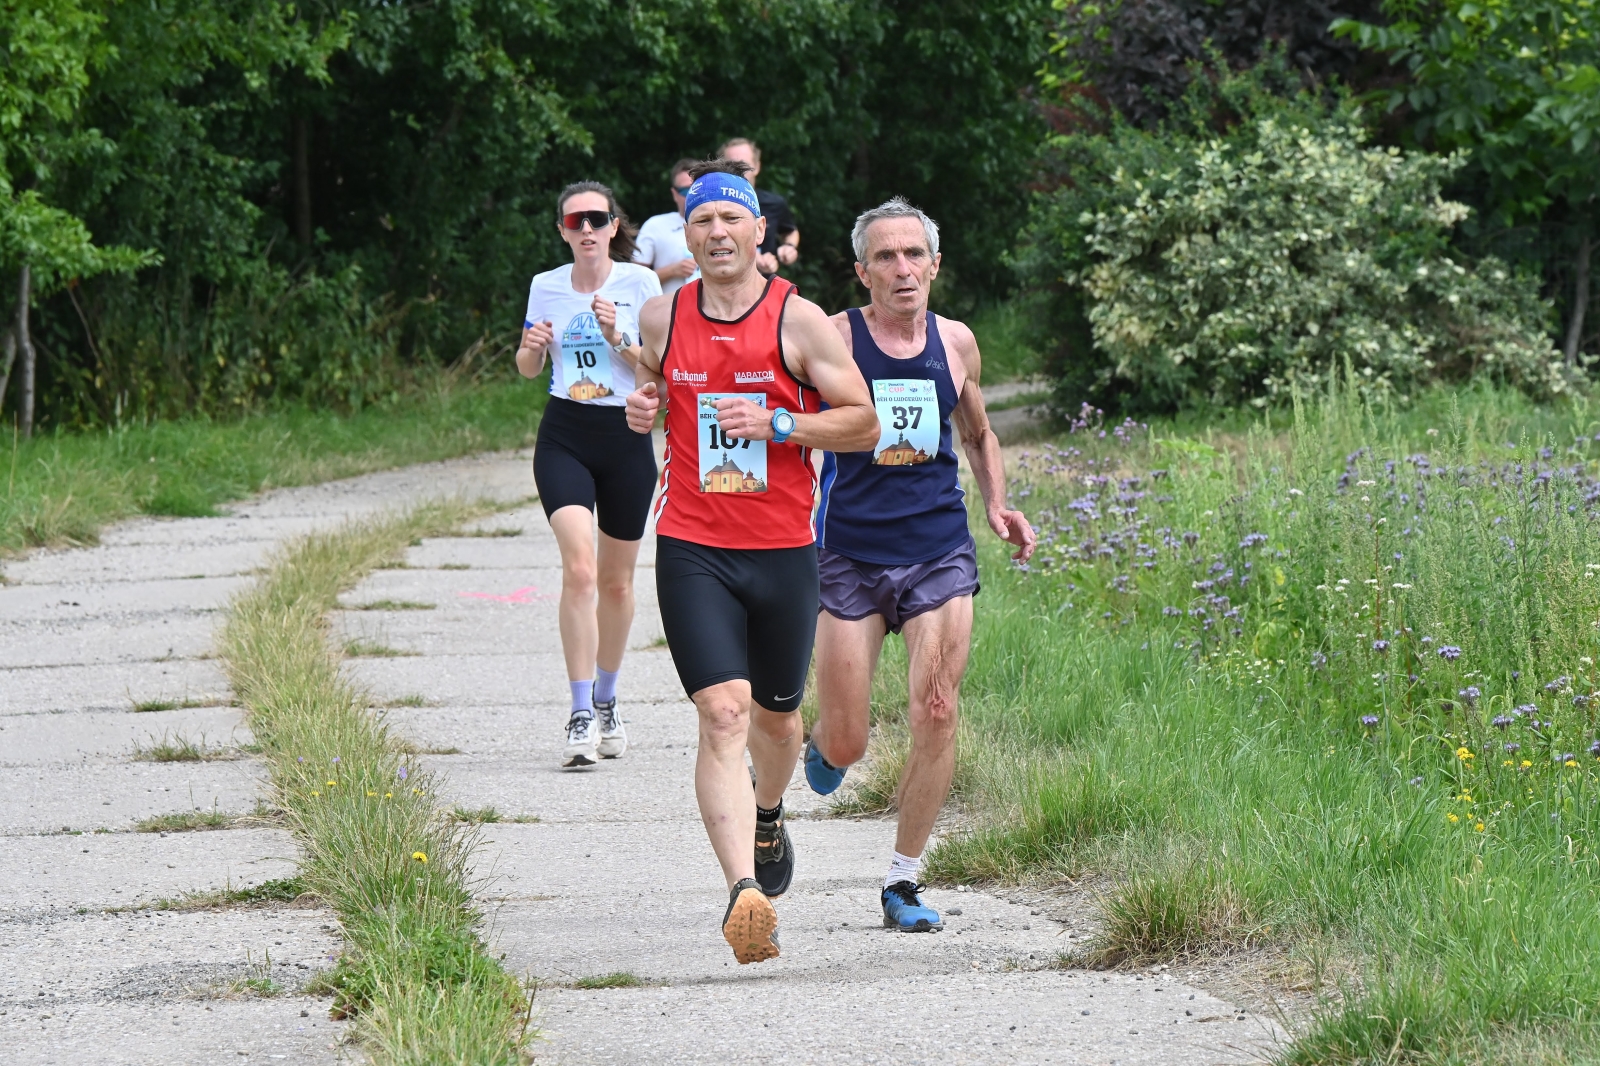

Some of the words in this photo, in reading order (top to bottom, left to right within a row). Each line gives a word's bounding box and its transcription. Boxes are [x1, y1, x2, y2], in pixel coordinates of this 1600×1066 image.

[575, 350, 597, 369] 10
[734, 370, 774, 379] MARATON
[891, 405, 923, 430] 37
